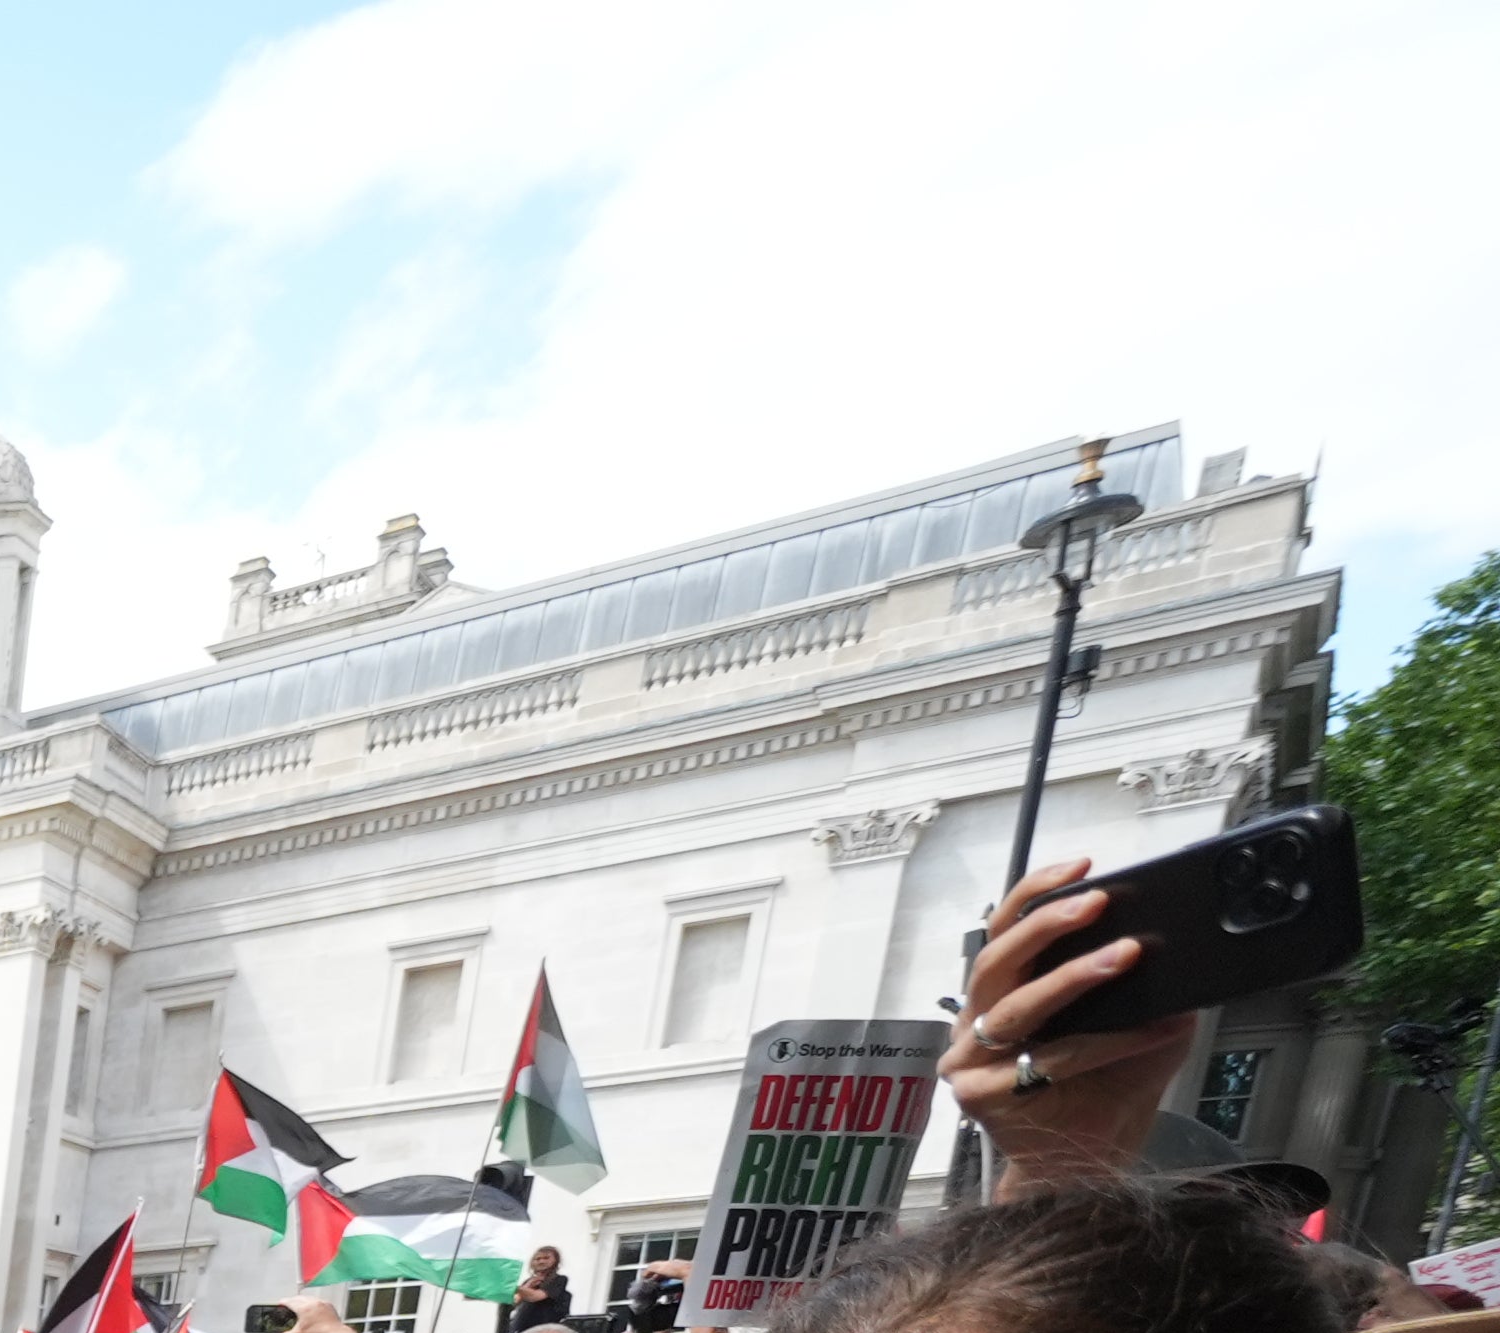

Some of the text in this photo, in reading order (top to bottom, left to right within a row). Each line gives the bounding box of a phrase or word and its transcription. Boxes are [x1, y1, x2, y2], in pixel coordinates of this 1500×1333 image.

[799, 1043, 836, 1059] Stop
[839, 1043, 869, 1057] the
[869, 1044, 901, 1058] War
[749, 1075, 893, 1132] DEFEND
[730, 1134, 885, 1206] RIGHT
[712, 1208, 896, 1278] PROTE
[703, 1279, 765, 1311] DROP
